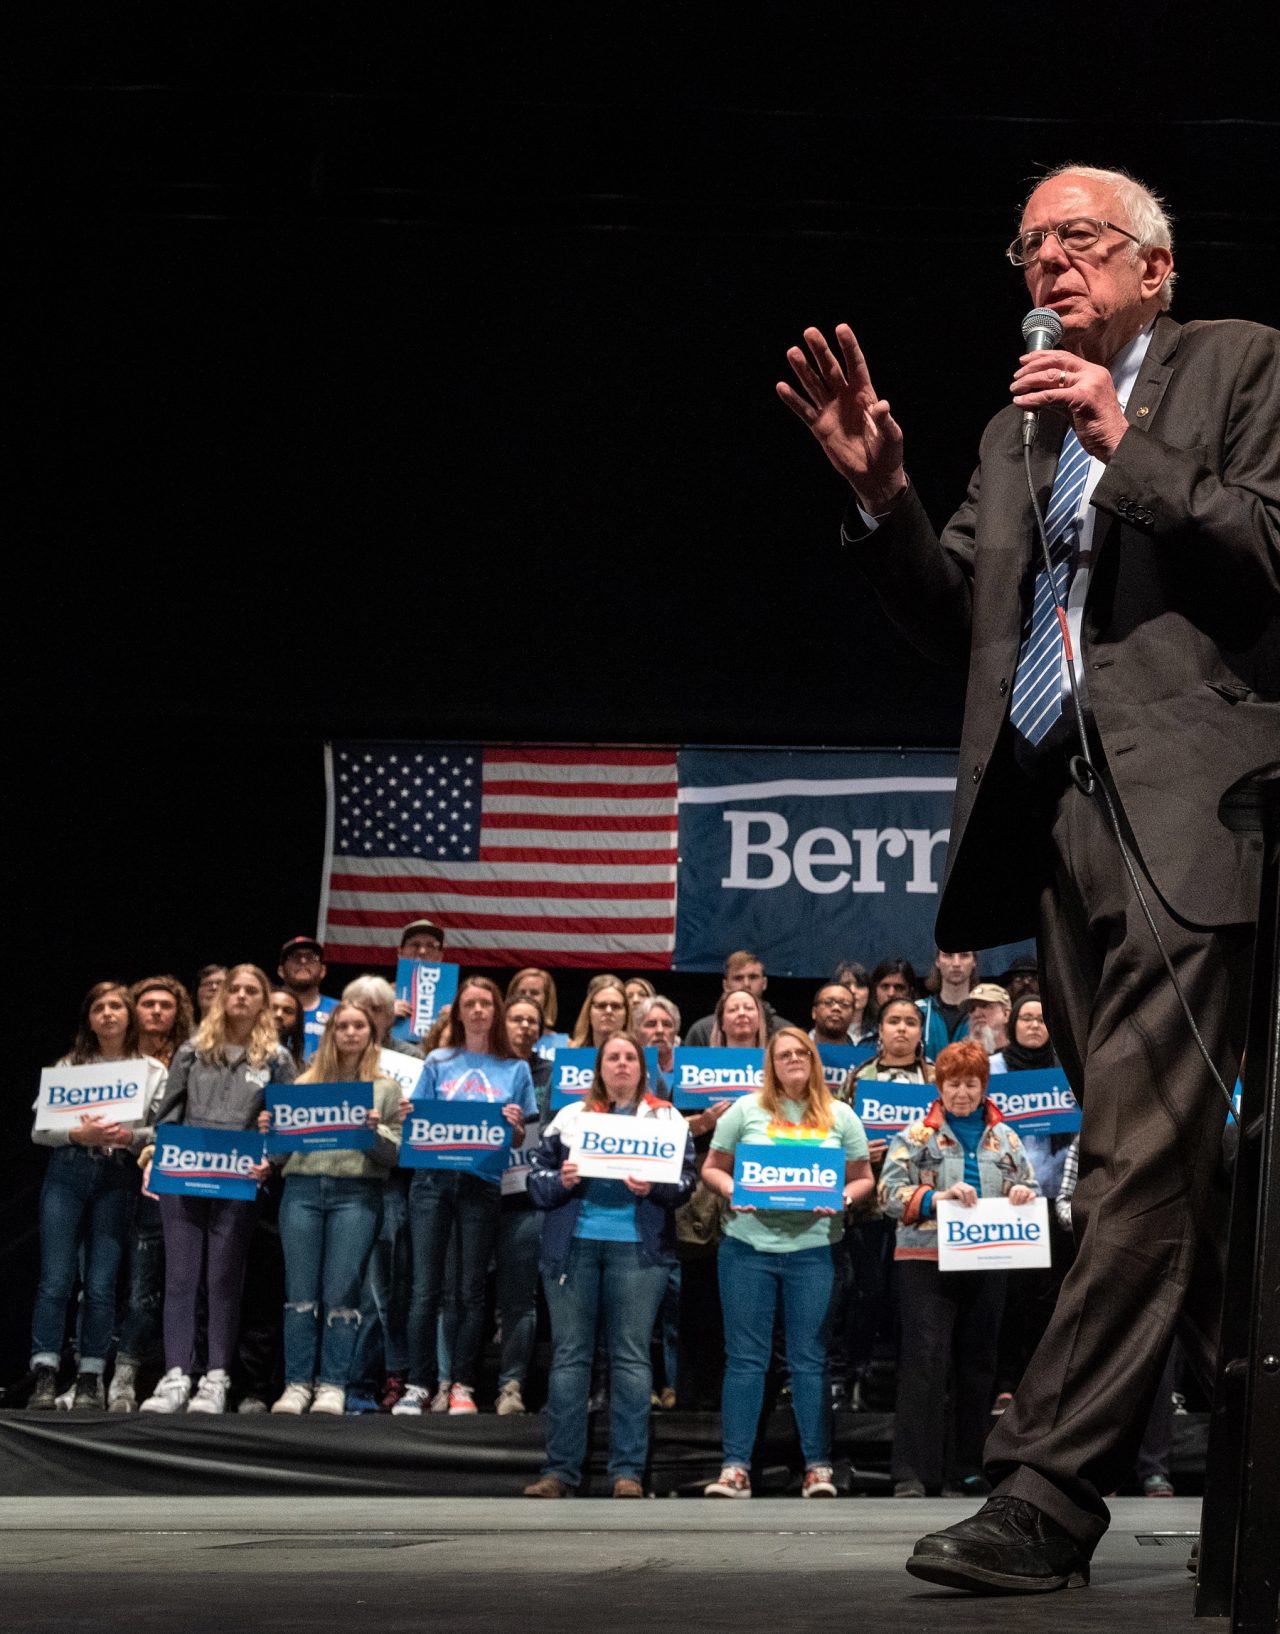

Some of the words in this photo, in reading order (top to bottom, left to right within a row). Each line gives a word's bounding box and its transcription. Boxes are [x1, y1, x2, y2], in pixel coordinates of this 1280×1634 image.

[721, 811, 950, 894] Bern
[414, 966, 441, 1037] Bernie
[48, 1079, 139, 1107] Bernie
[273, 1100, 368, 1128] Bernie
[409, 1118, 506, 1146] Bernie
[581, 1131, 676, 1159] Bernie
[159, 1144, 255, 1176] Bernie
[741, 1161, 838, 1188] Bernie
[947, 1218, 1041, 1244] Bernie
